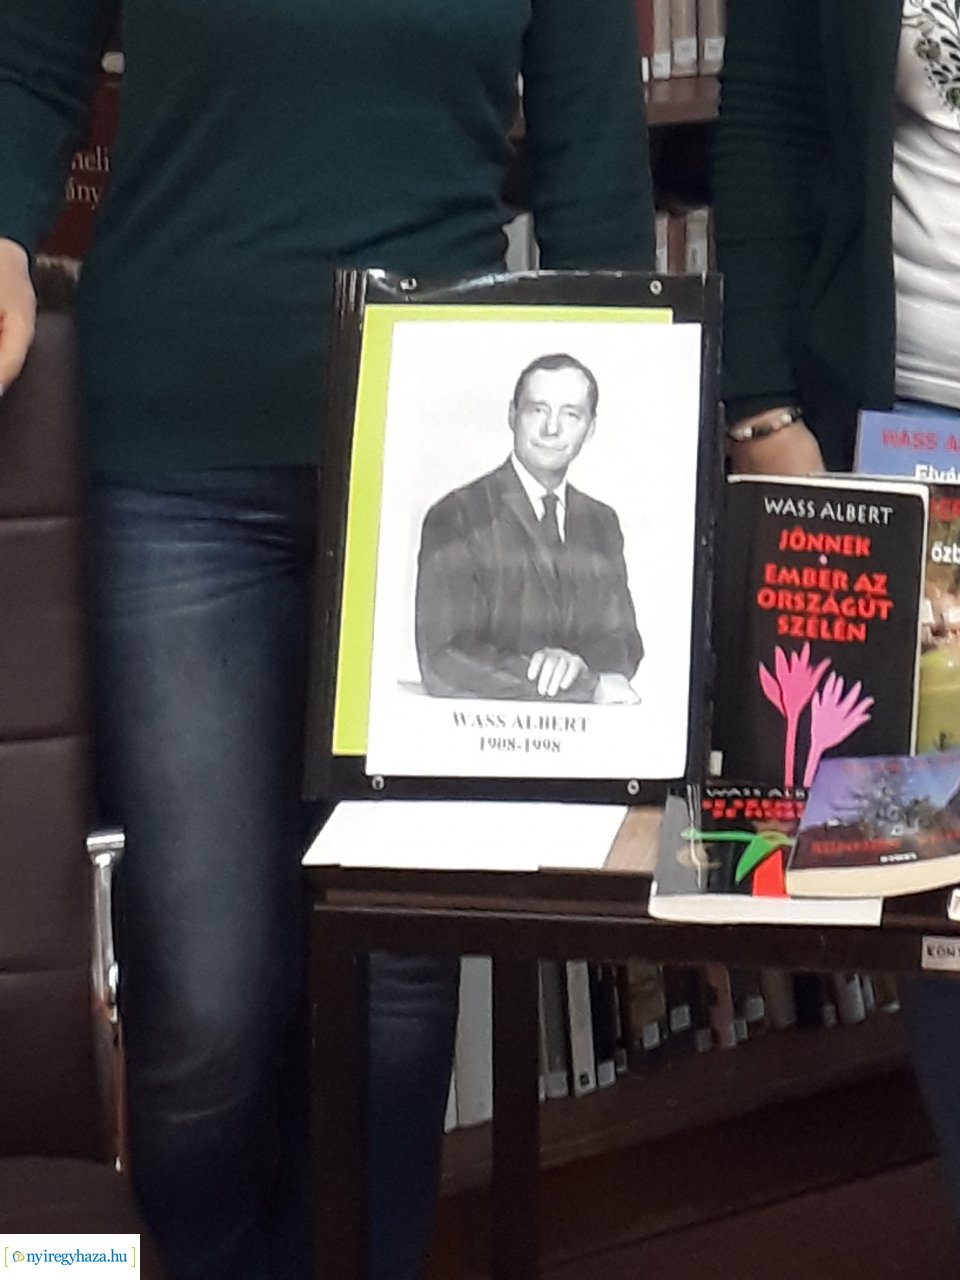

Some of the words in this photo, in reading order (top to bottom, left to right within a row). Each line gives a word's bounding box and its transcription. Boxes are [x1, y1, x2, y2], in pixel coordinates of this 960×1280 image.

[882, 429, 937, 451] WASS
[764, 496, 815, 518] WASS
[820, 502, 893, 524] ALBERT
[764, 563, 848, 591] EMBER
[853, 572, 887, 595] AZ
[453, 711, 506, 729] WASS
[512, 714, 591, 733] ALBERT
[480, 736, 561, 753] 1908-1998
